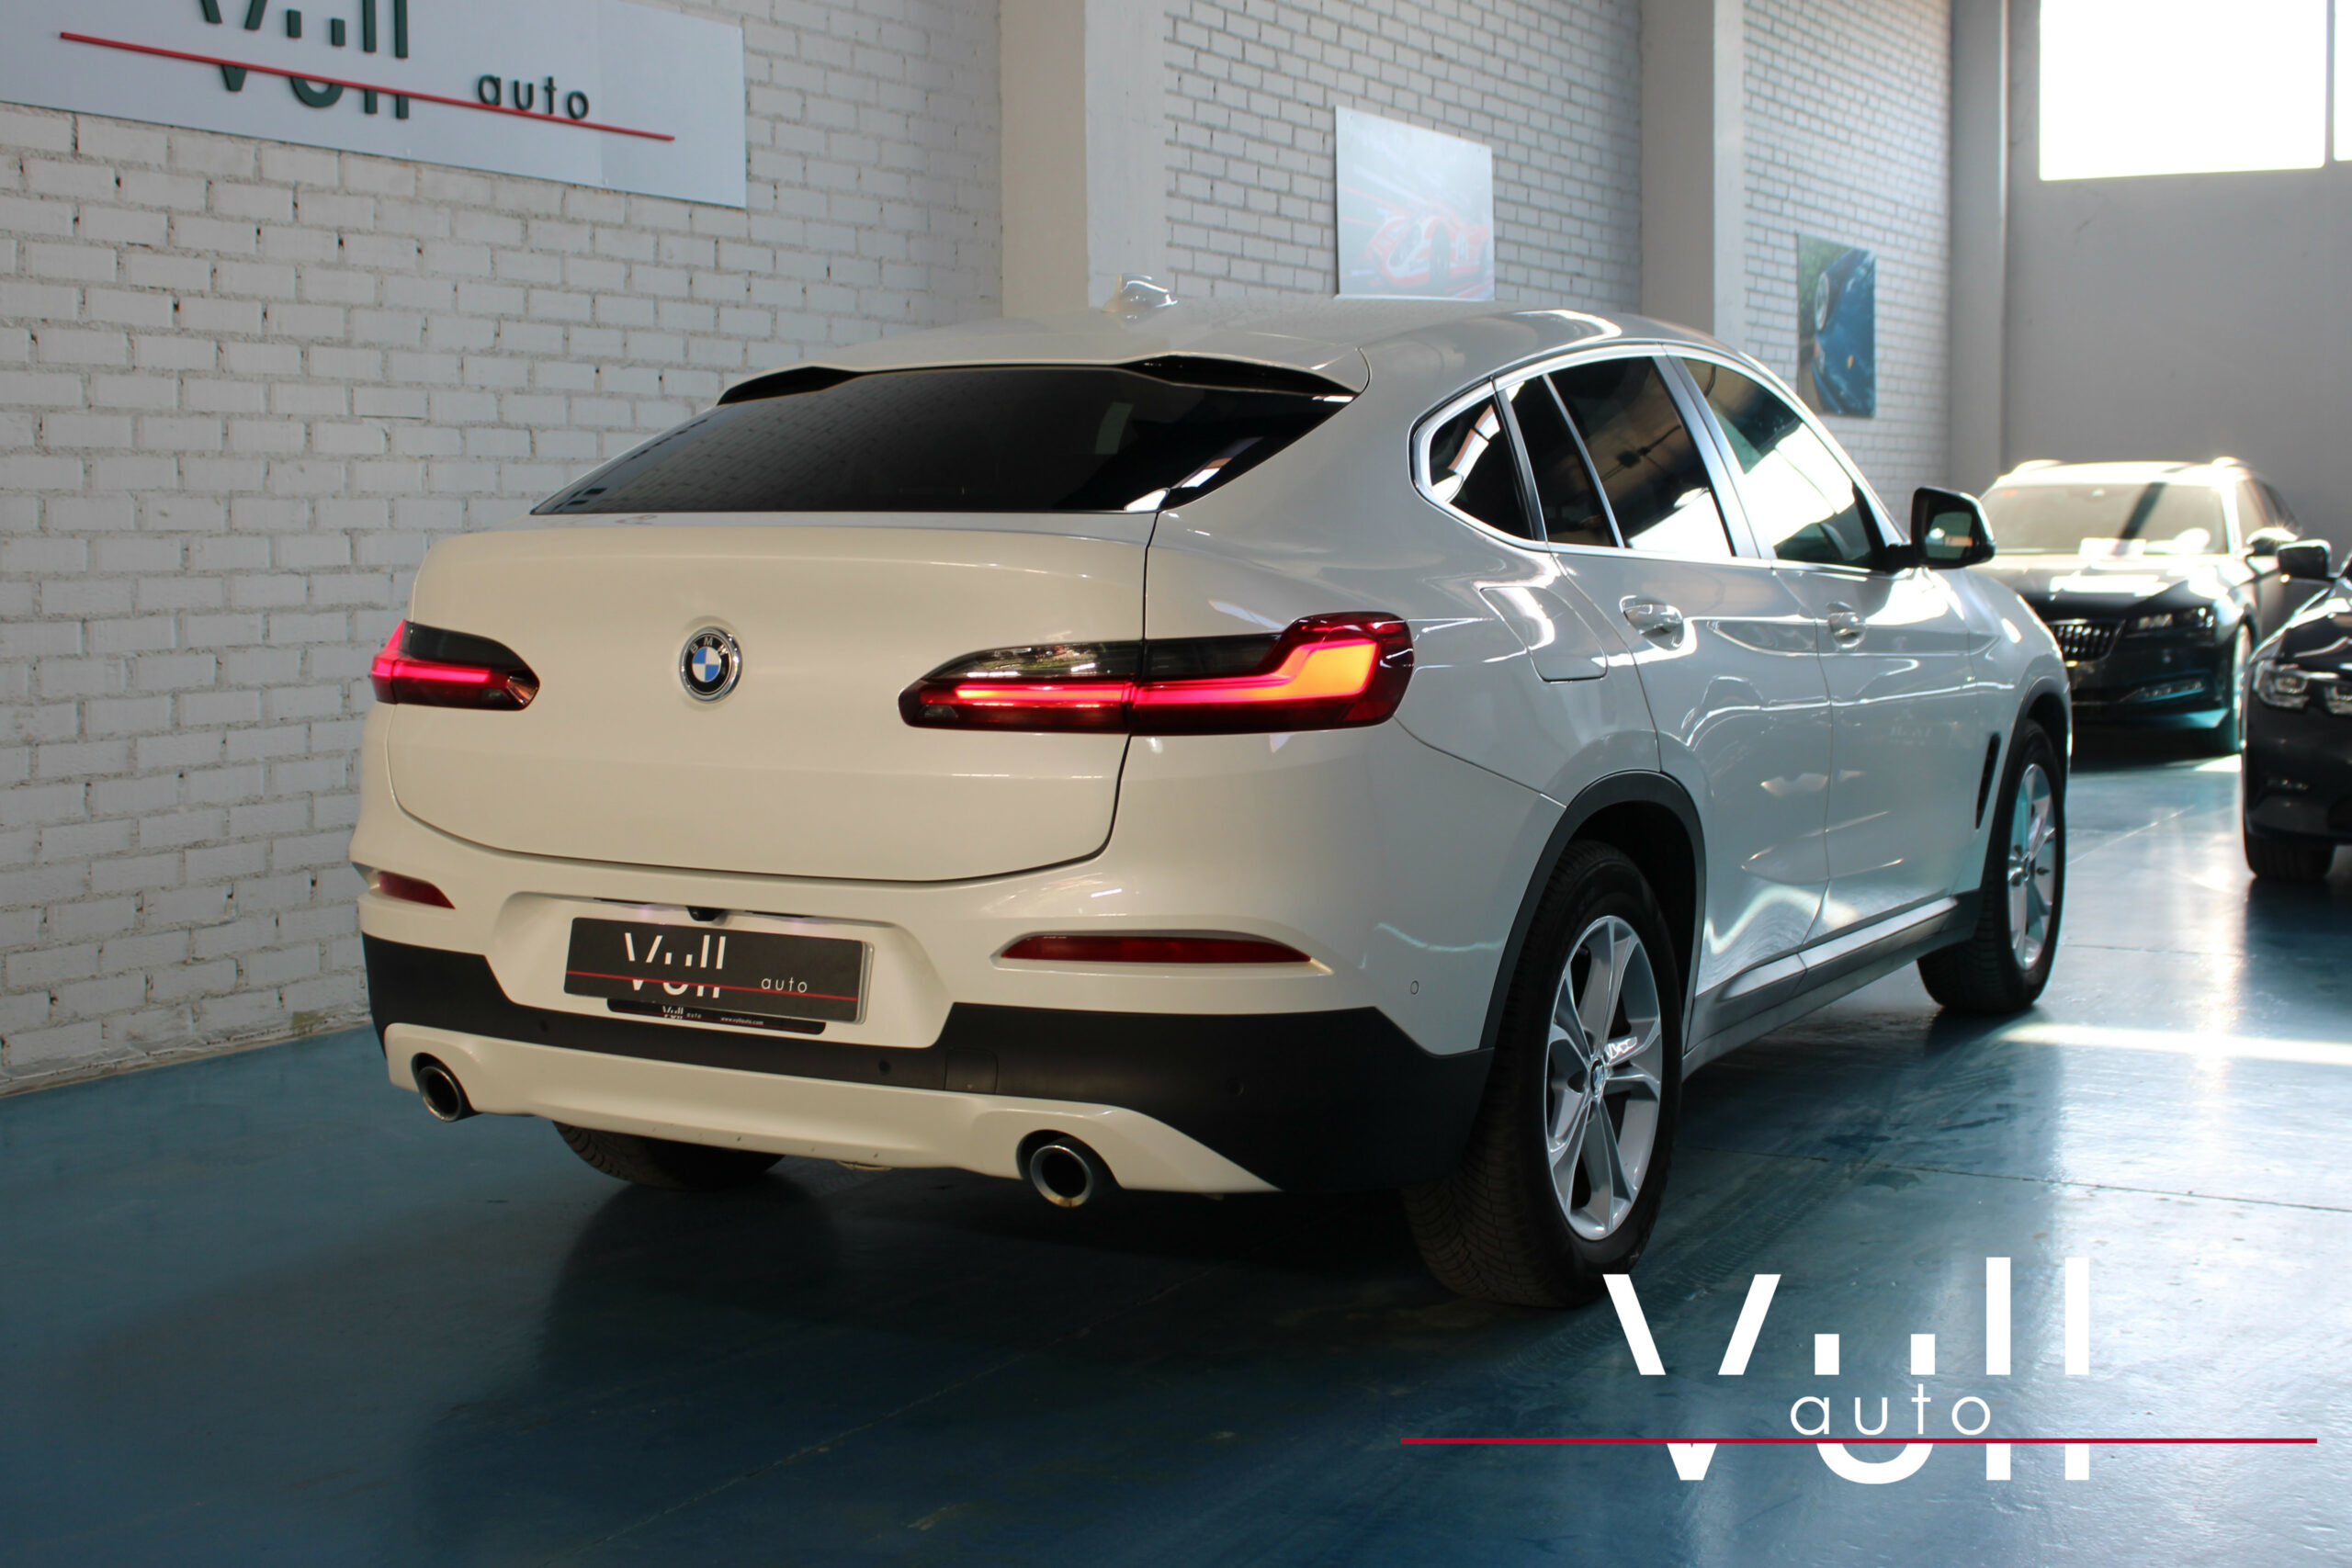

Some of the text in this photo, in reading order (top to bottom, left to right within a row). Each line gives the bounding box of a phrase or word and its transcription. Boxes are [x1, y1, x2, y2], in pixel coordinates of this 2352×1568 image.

[477, 73, 590, 120] auto
[690, 637, 729, 656] BMW
[761, 976, 808, 994] auto
